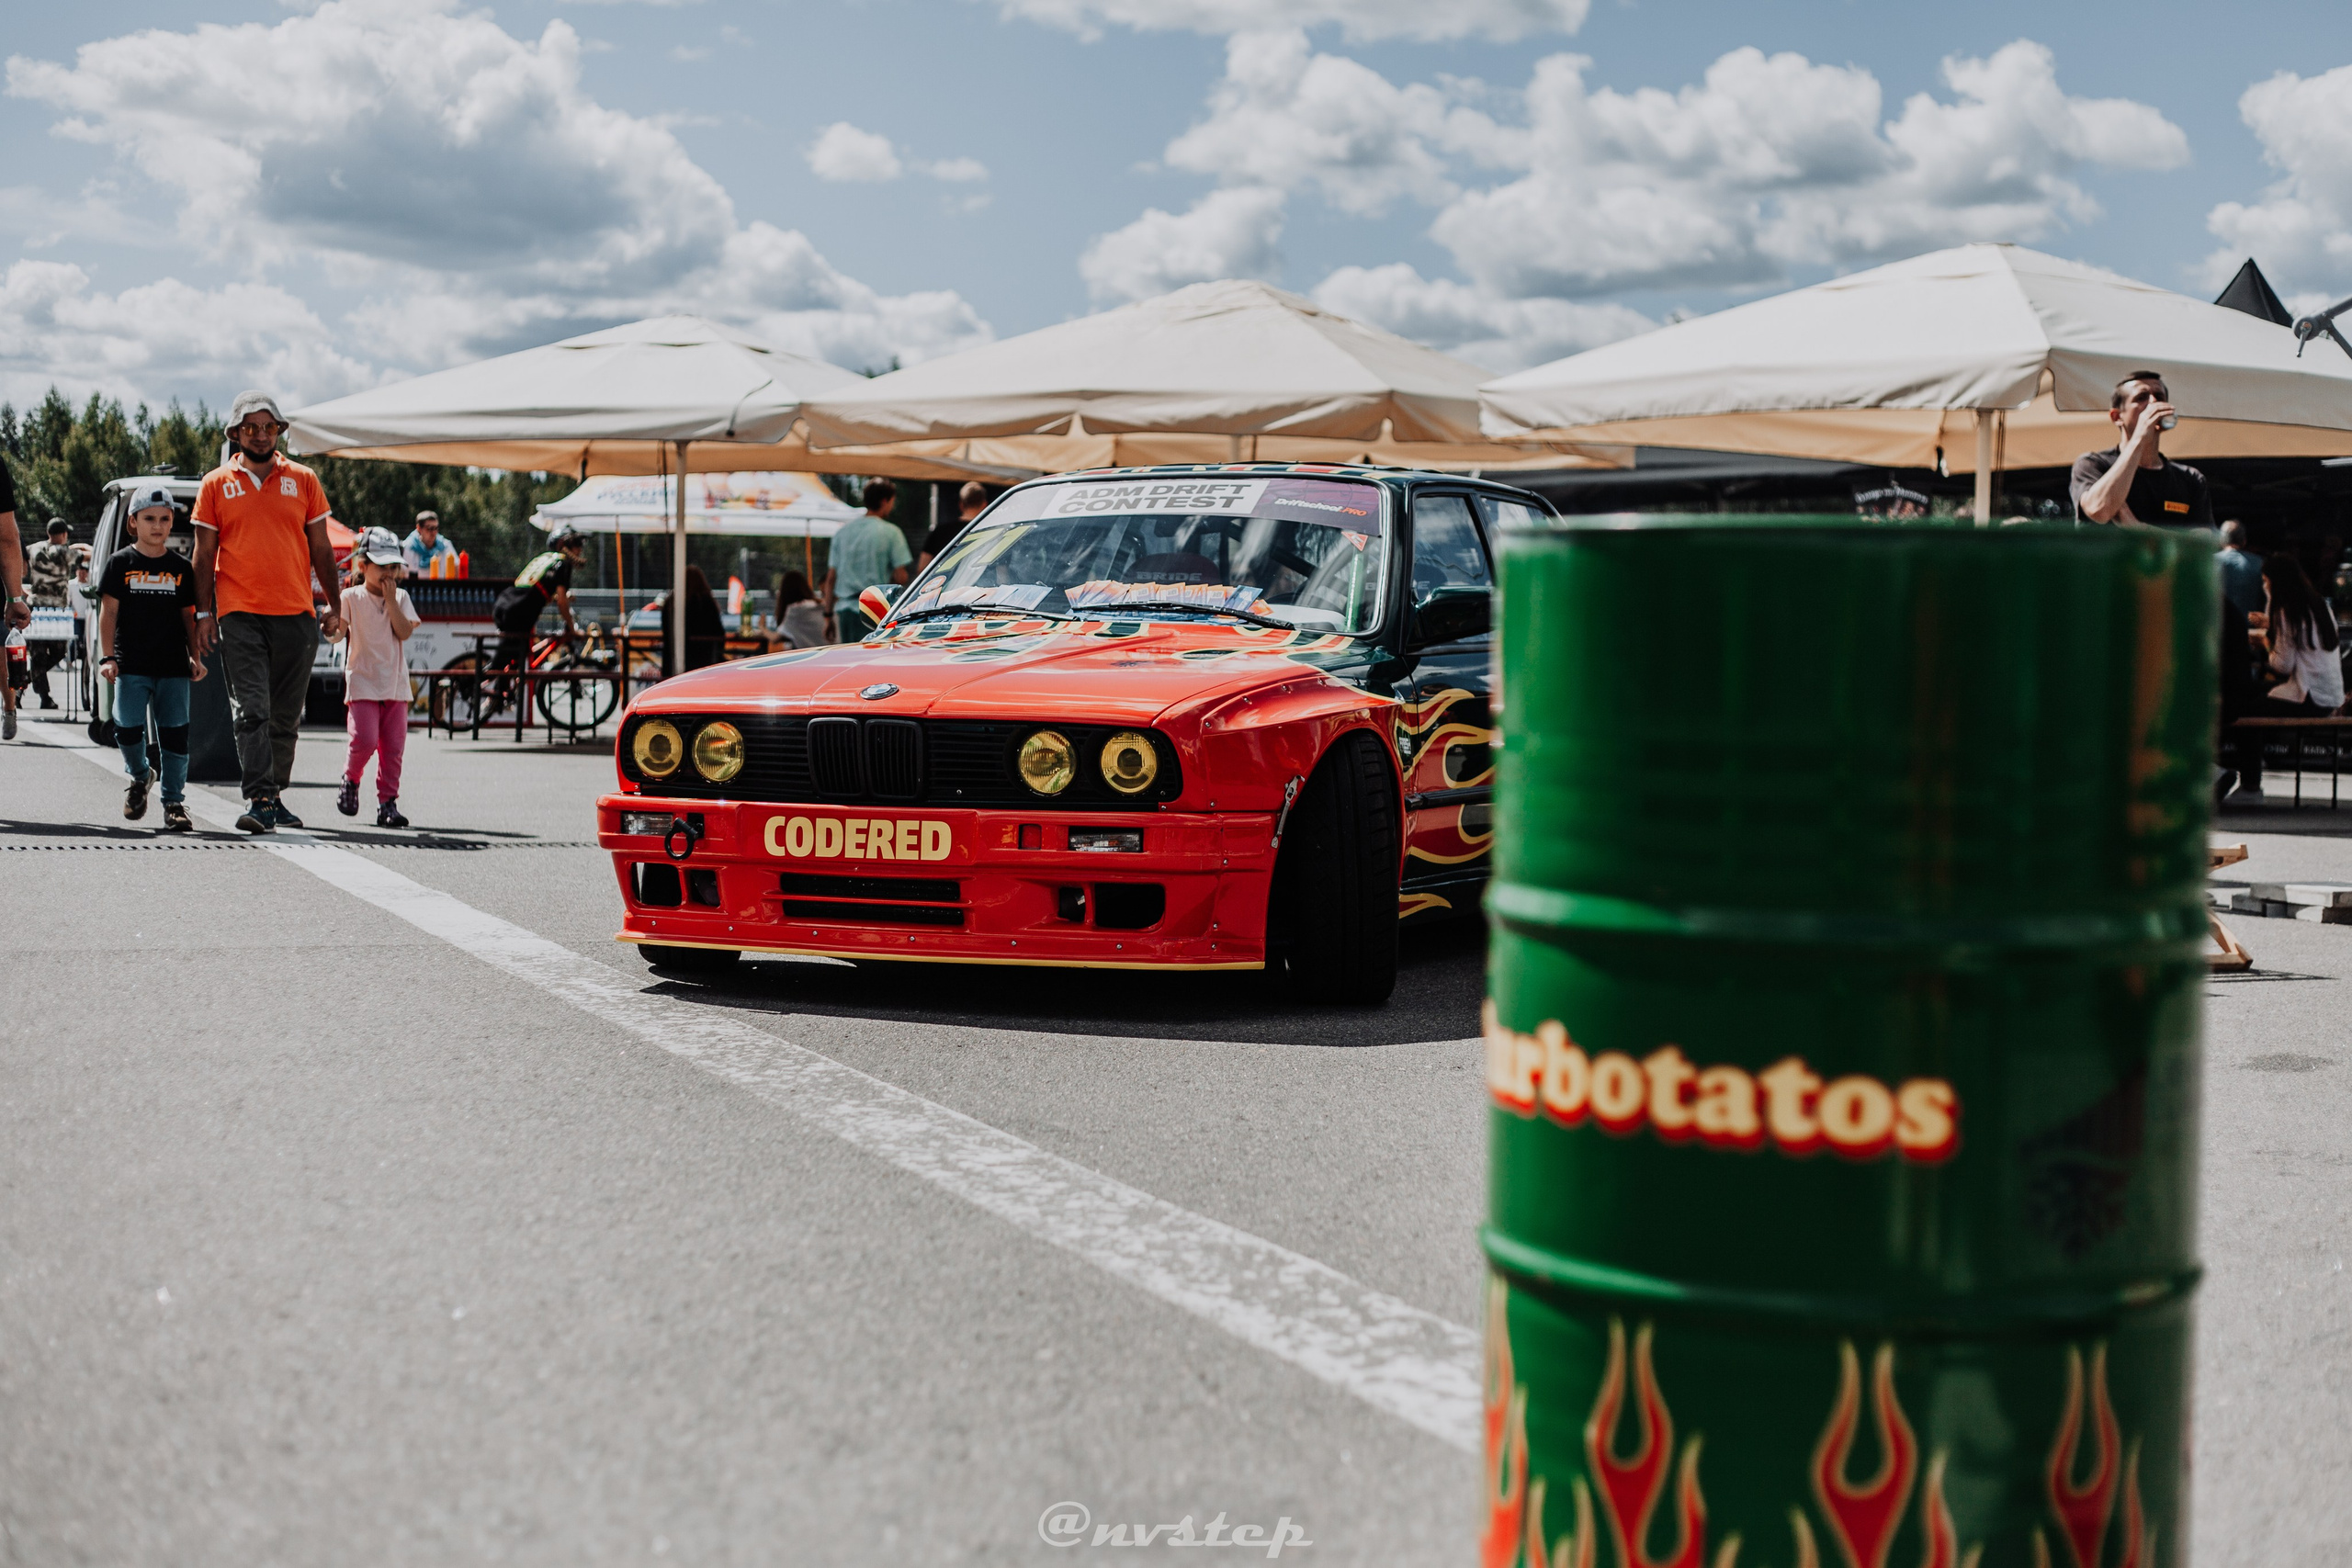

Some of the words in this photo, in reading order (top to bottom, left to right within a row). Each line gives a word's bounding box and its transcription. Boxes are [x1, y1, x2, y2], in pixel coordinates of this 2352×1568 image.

[222, 479, 246, 500] 01
[1067, 486, 1146, 501] ADM
[1148, 483, 1252, 496] DRIFT
[1057, 495, 1244, 514] CONTEST
[935, 523, 1036, 573] 71
[1136, 571, 1202, 581] BRIDE
[763, 815, 953, 862] CODERED
[1481, 995, 1959, 1161] urbotatos
